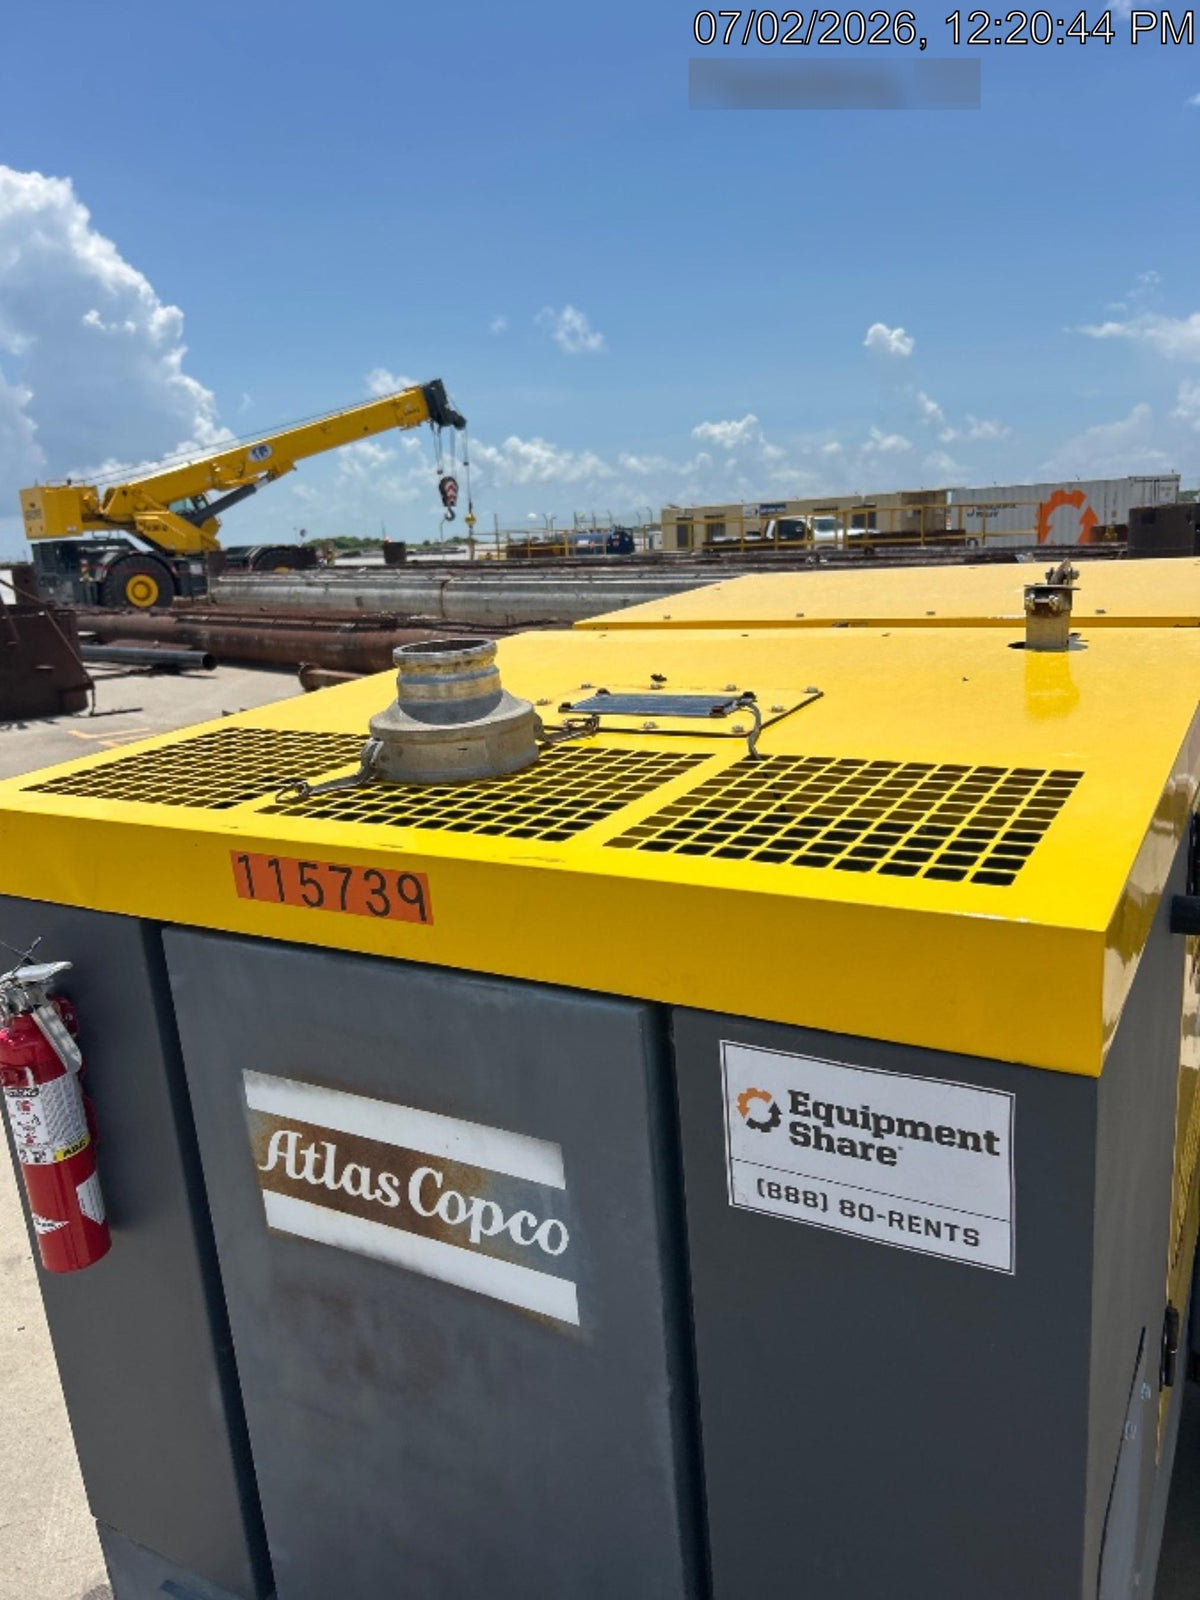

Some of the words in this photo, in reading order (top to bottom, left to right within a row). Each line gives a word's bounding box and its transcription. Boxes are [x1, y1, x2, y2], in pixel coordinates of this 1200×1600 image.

[238, 854, 427, 922] 115739
[787, 1088, 1000, 1156] Equipment
[788, 1121, 898, 1167] Share
[258, 1130, 401, 1208] Atlas
[408, 1166, 569, 1256] Copco
[757, 1178, 828, 1213] (888)
[839, 1199, 980, 1247] 80-RENTS
